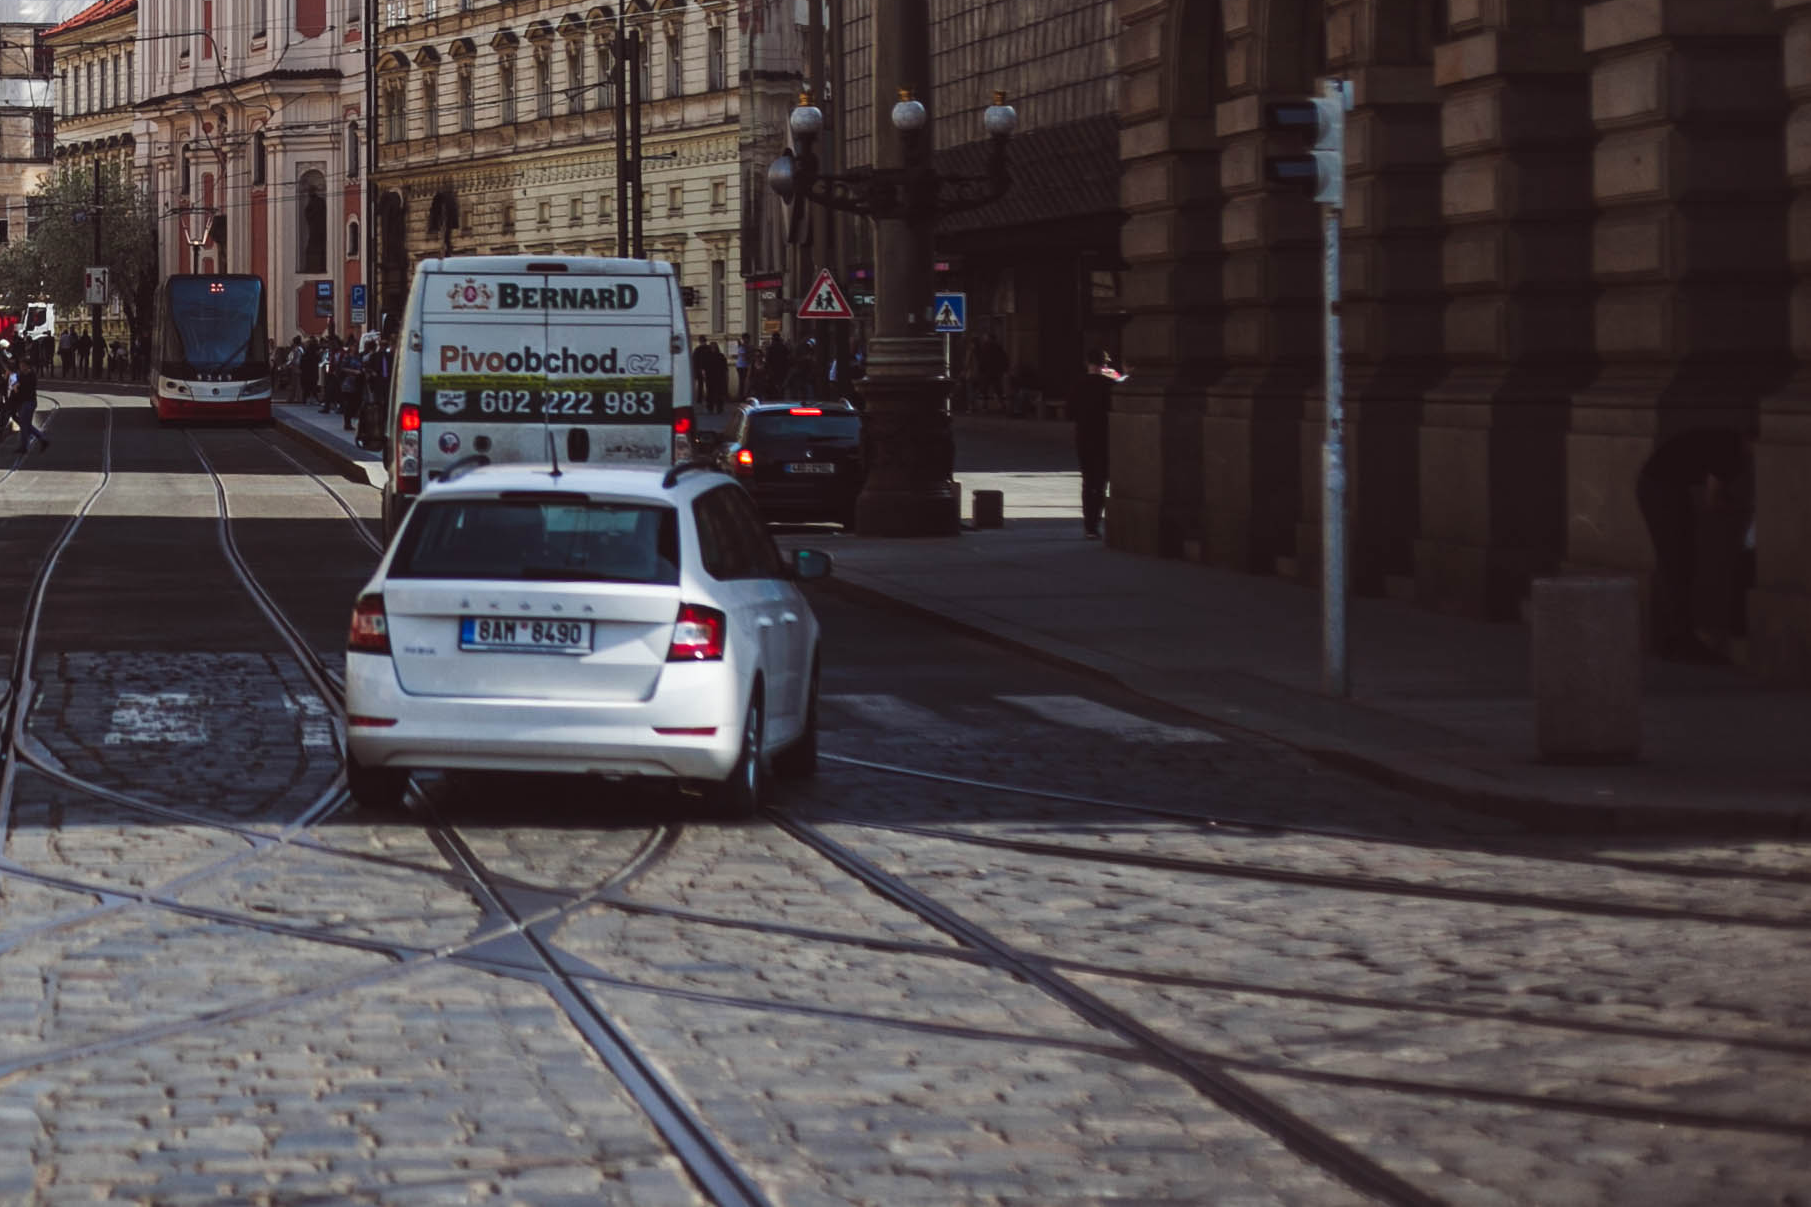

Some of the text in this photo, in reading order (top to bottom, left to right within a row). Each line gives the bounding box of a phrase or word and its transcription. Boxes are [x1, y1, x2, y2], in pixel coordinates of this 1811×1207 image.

[497, 282, 639, 310] BERNARD
[440, 345, 660, 375] Pivoobchod.cz
[480, 389, 655, 415] 602 222 983
[531, 622, 582, 644] 8490
